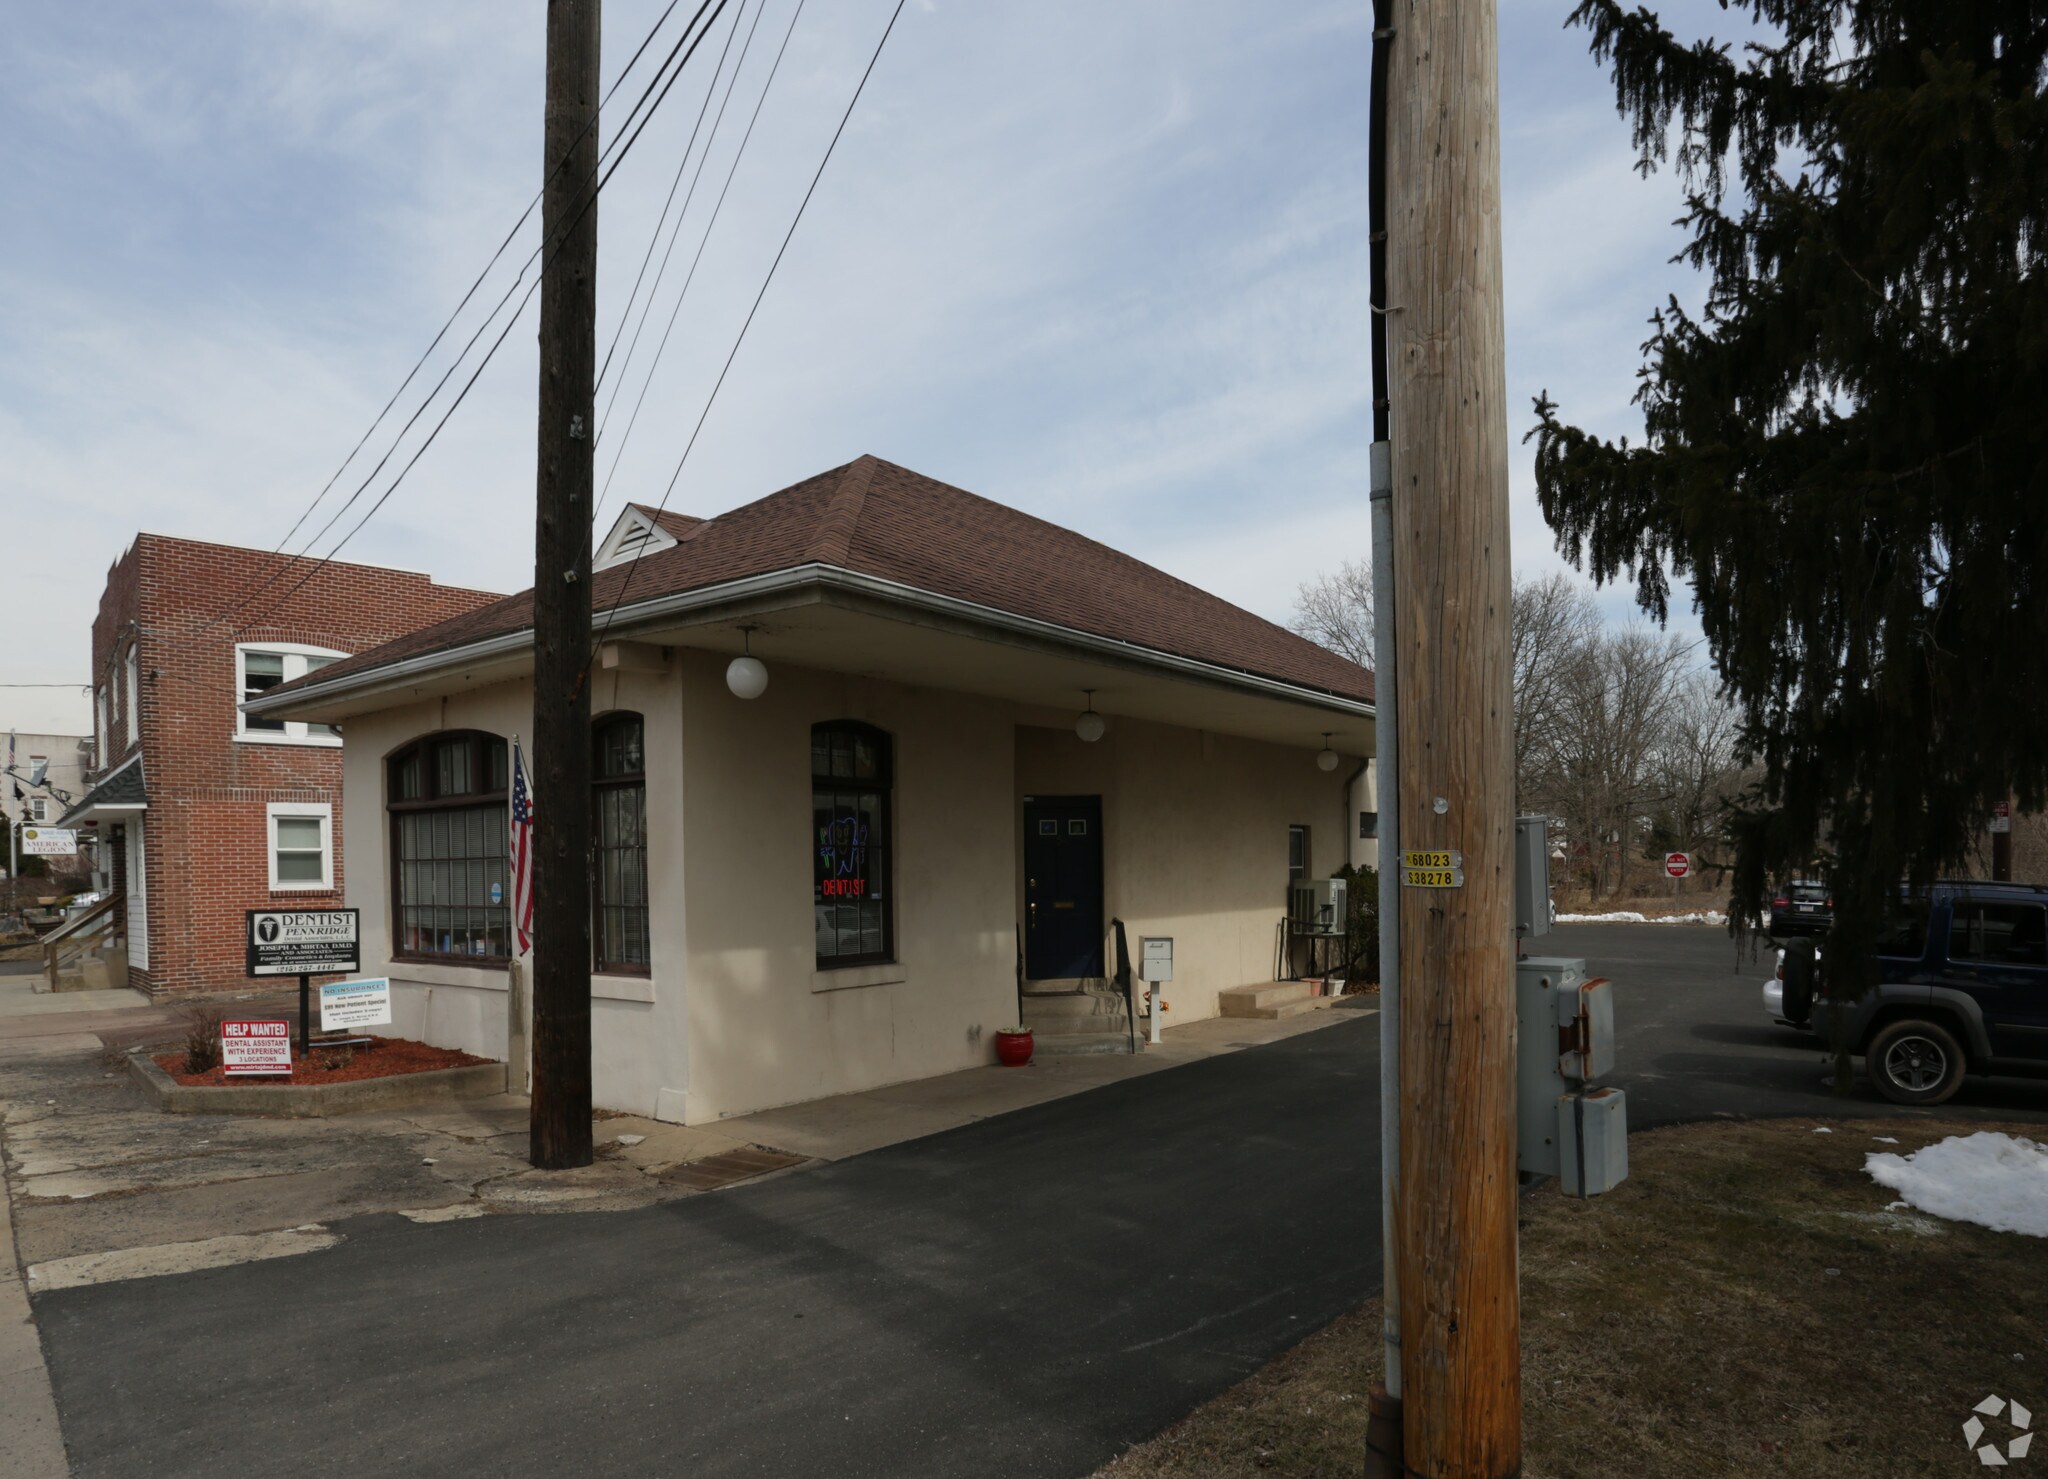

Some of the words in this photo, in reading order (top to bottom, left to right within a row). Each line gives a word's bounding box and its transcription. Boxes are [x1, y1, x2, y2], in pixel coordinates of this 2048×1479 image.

[823, 879, 865, 895] DENTIST
[282, 913, 353, 926] DENTIST
[286, 927, 351, 936] PENNRIDGE
[276, 965, 297, 973] (215)
[225, 1023, 249, 1036] HELP
[250, 1023, 286, 1036] WANTED
[253, 1039, 287, 1047] ASSISTANT
[246, 1047, 286, 1055] EXPERIENCE
